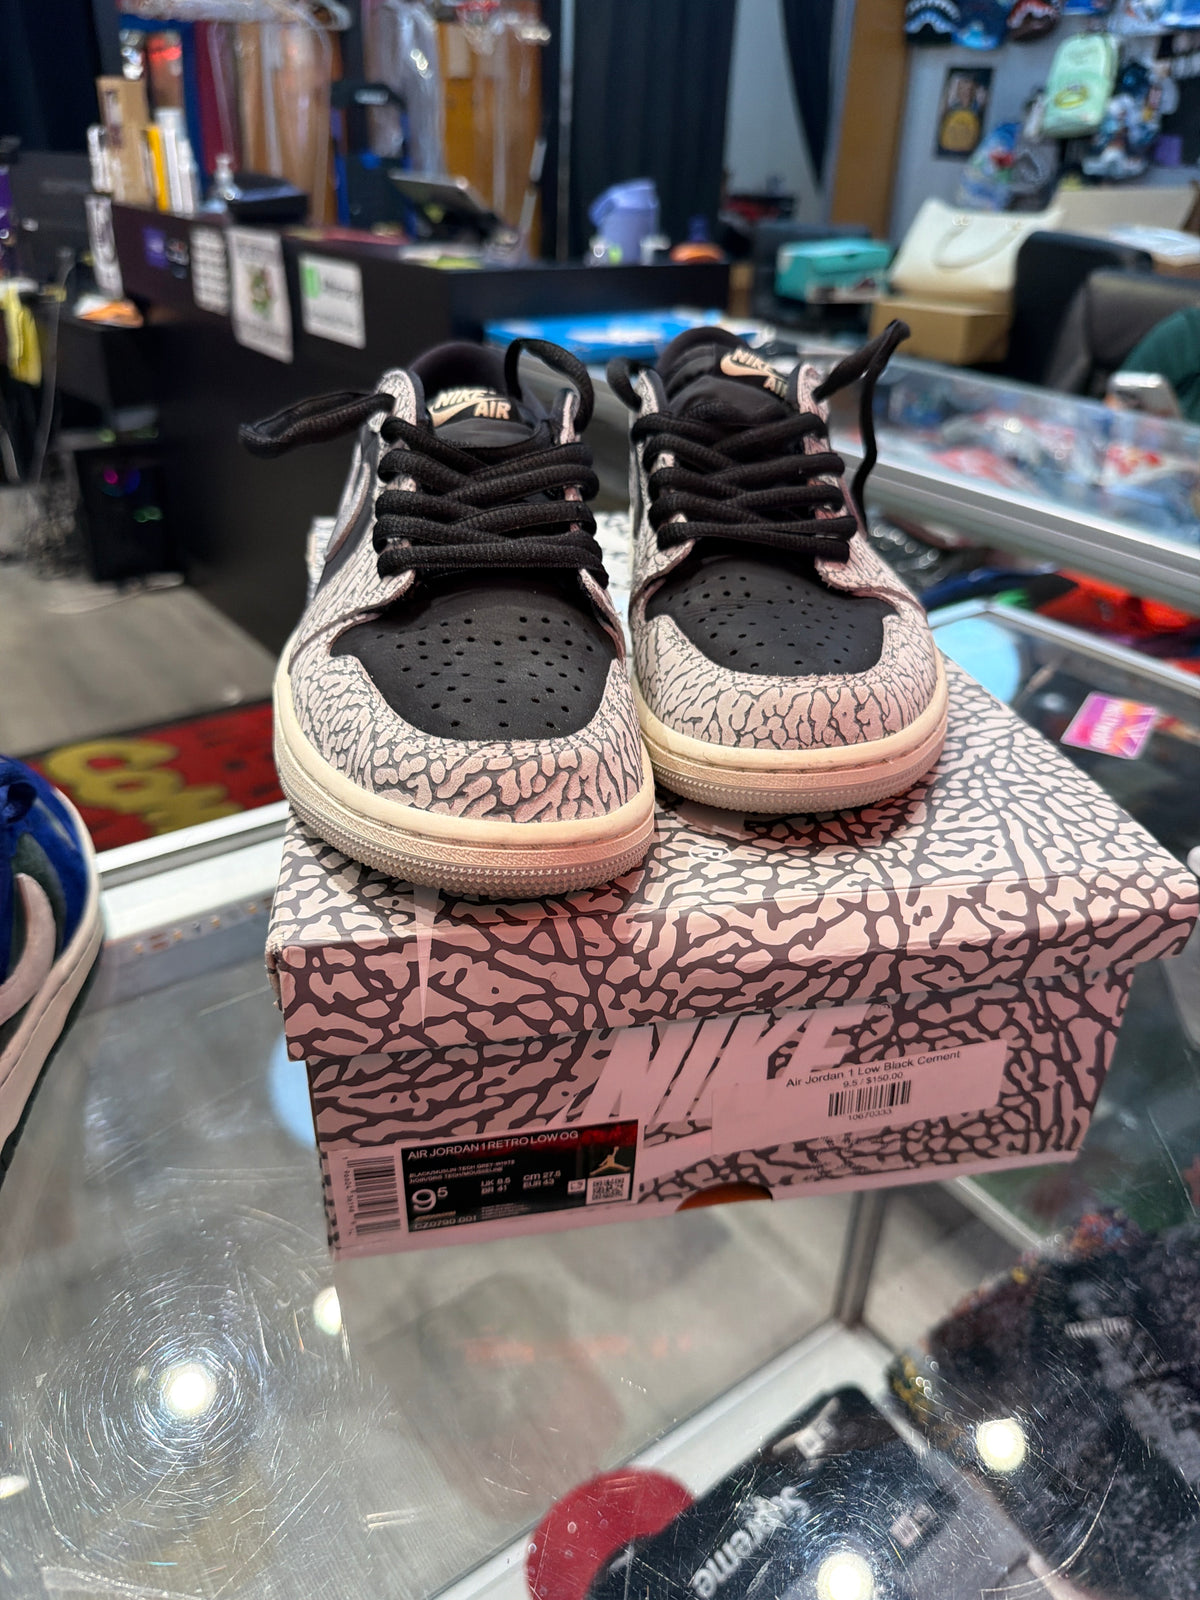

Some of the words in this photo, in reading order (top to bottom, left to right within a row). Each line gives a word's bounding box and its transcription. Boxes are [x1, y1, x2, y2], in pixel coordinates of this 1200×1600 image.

[434, 388, 489, 410] NIKE
[474, 400, 512, 420] AIR
[578, 1003, 874, 1127] NIKE
[786, 1078, 802, 1088] Air
[805, 1072, 844, 1085] Jordan
[858, 1065, 881, 1076] Low
[884, 1059, 914, 1071] Black
[917, 1051, 961, 1065] Cement
[843, 1079, 858, 1088] 9.5
[866, 1072, 904, 1085] $150.00
[408, 1149, 428, 1161] AIR
[430, 1142, 479, 1158] JORDAN
[487, 1136, 529, 1151] RETRO
[530, 1132, 559, 1145] LOW
[559, 1129, 579, 1141] OG
